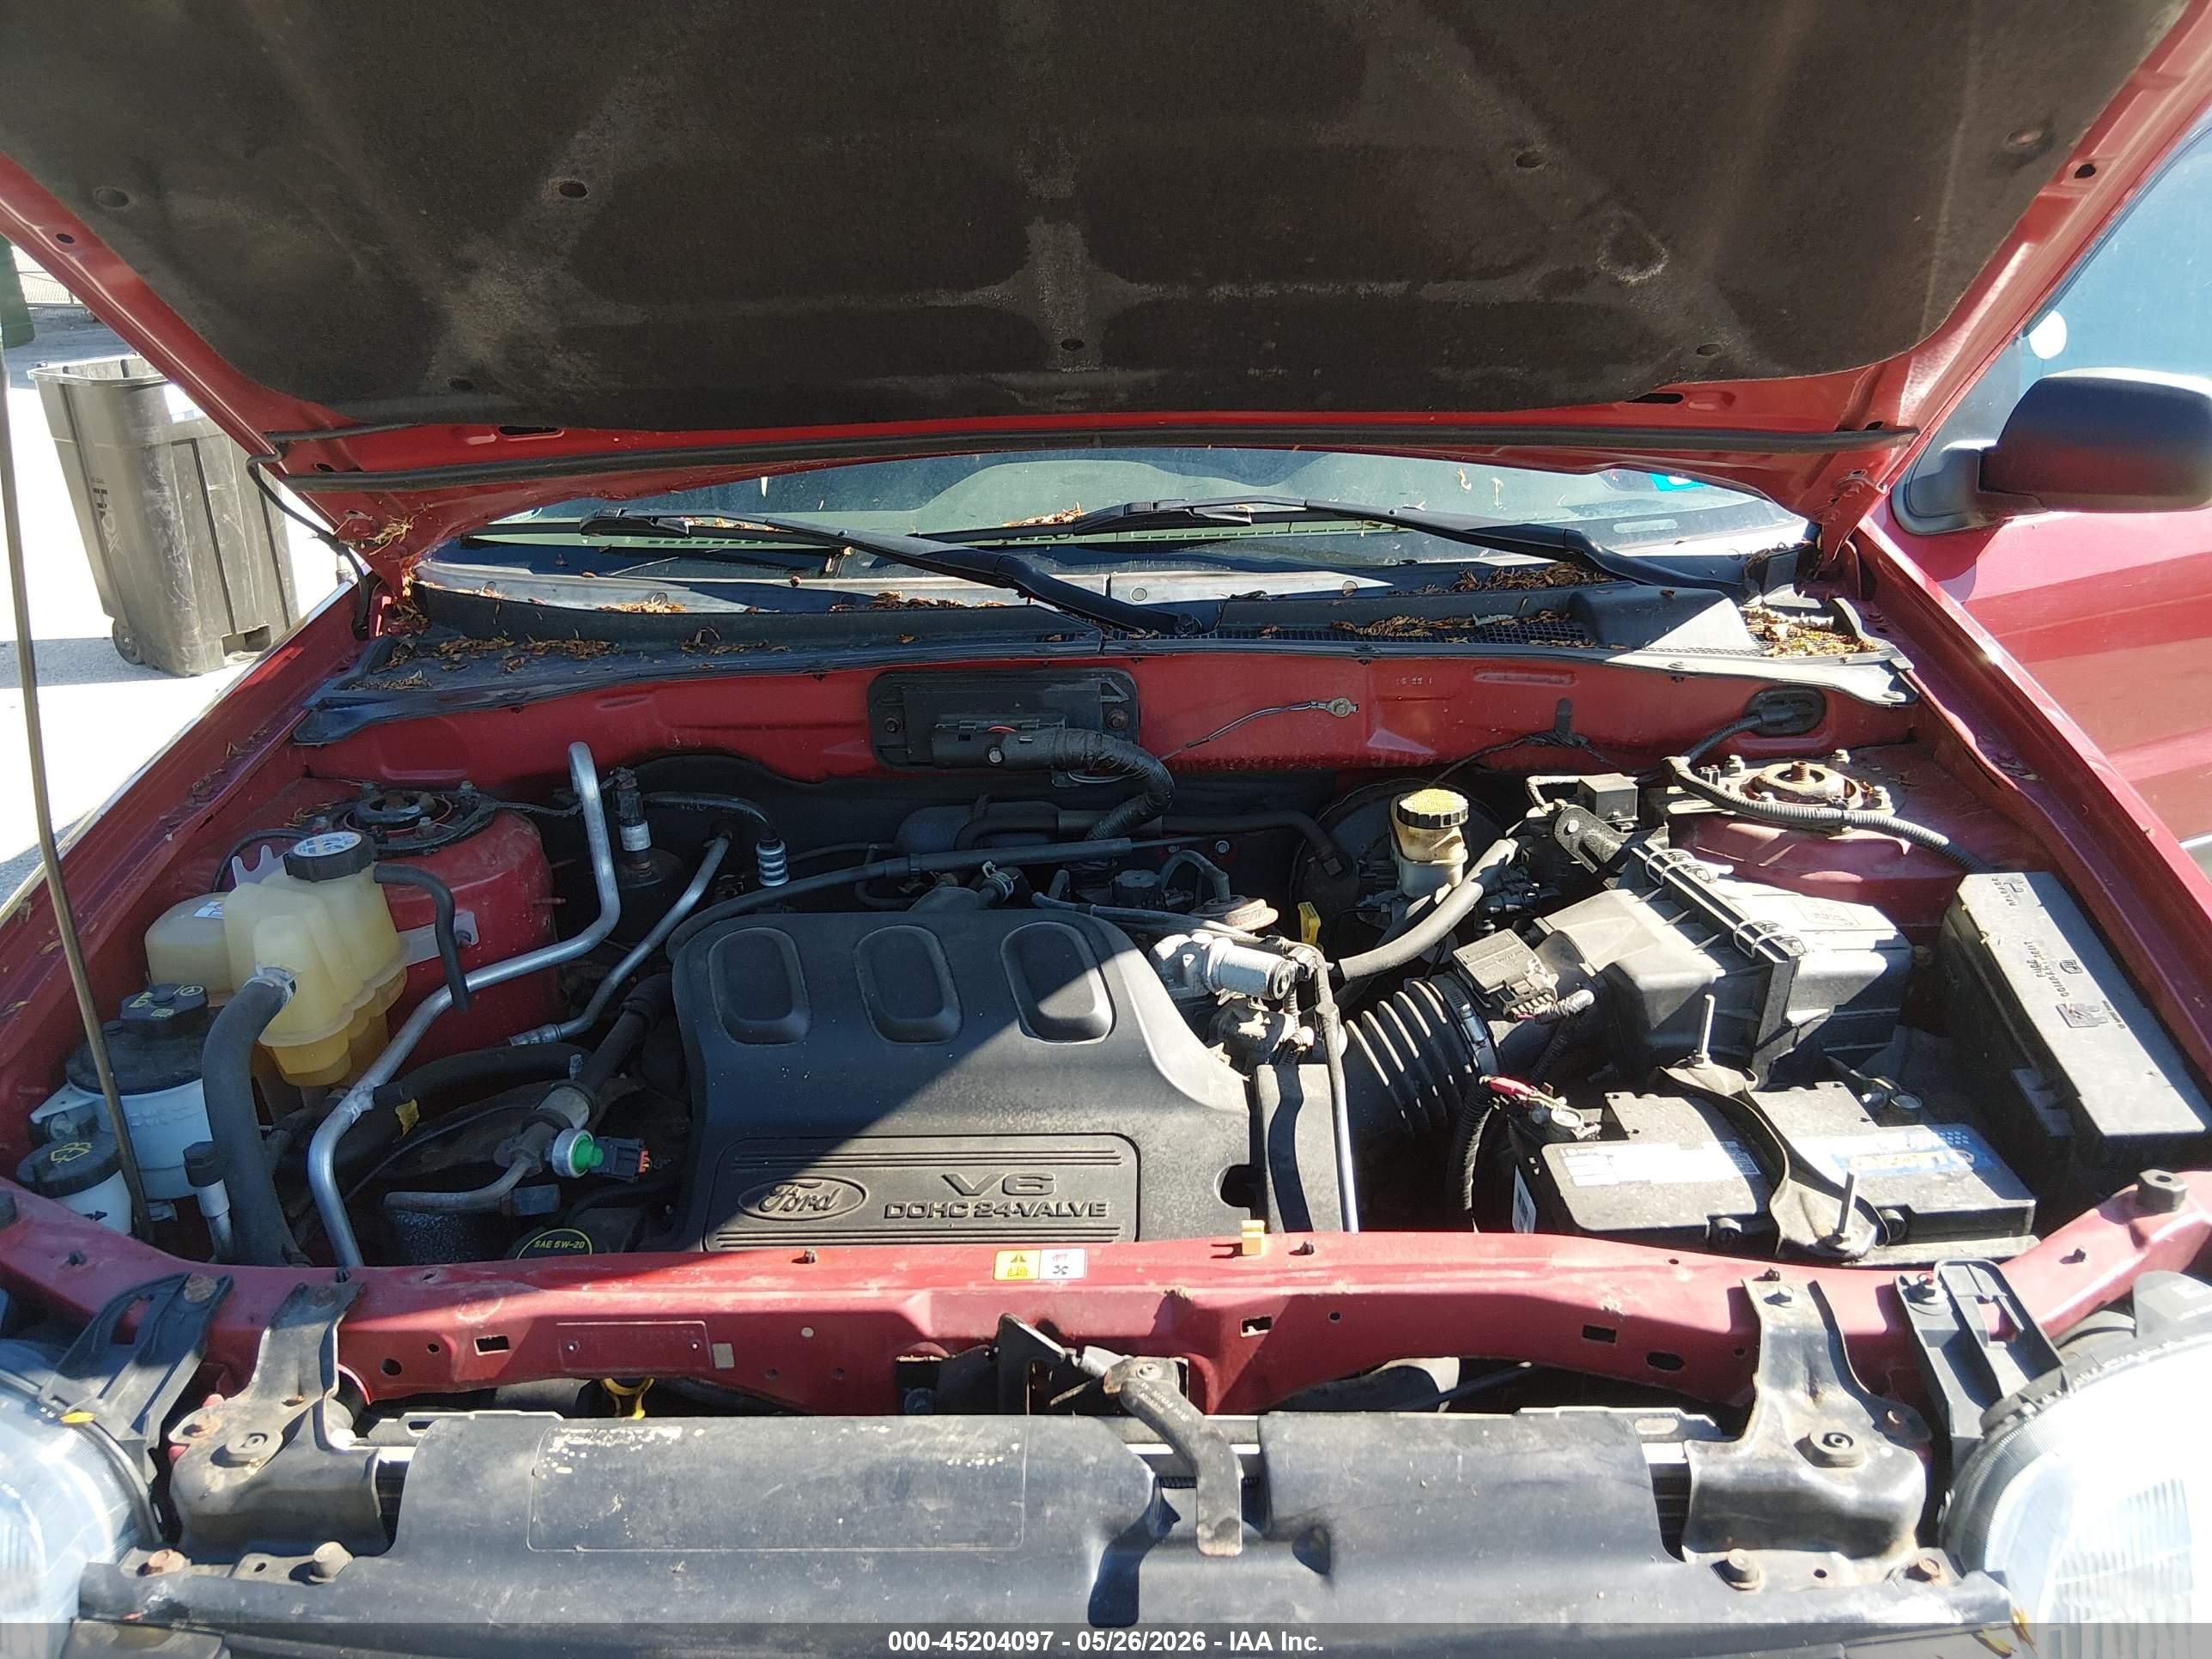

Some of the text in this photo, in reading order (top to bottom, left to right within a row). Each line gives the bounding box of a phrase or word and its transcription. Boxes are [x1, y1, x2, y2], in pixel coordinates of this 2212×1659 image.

[940, 1171, 1057, 1197] V6
[757, 1181, 842, 1213] Ford
[884, 1201, 969, 1219] DOHC
[533, 1240, 586, 1249] SAE 5W-20
